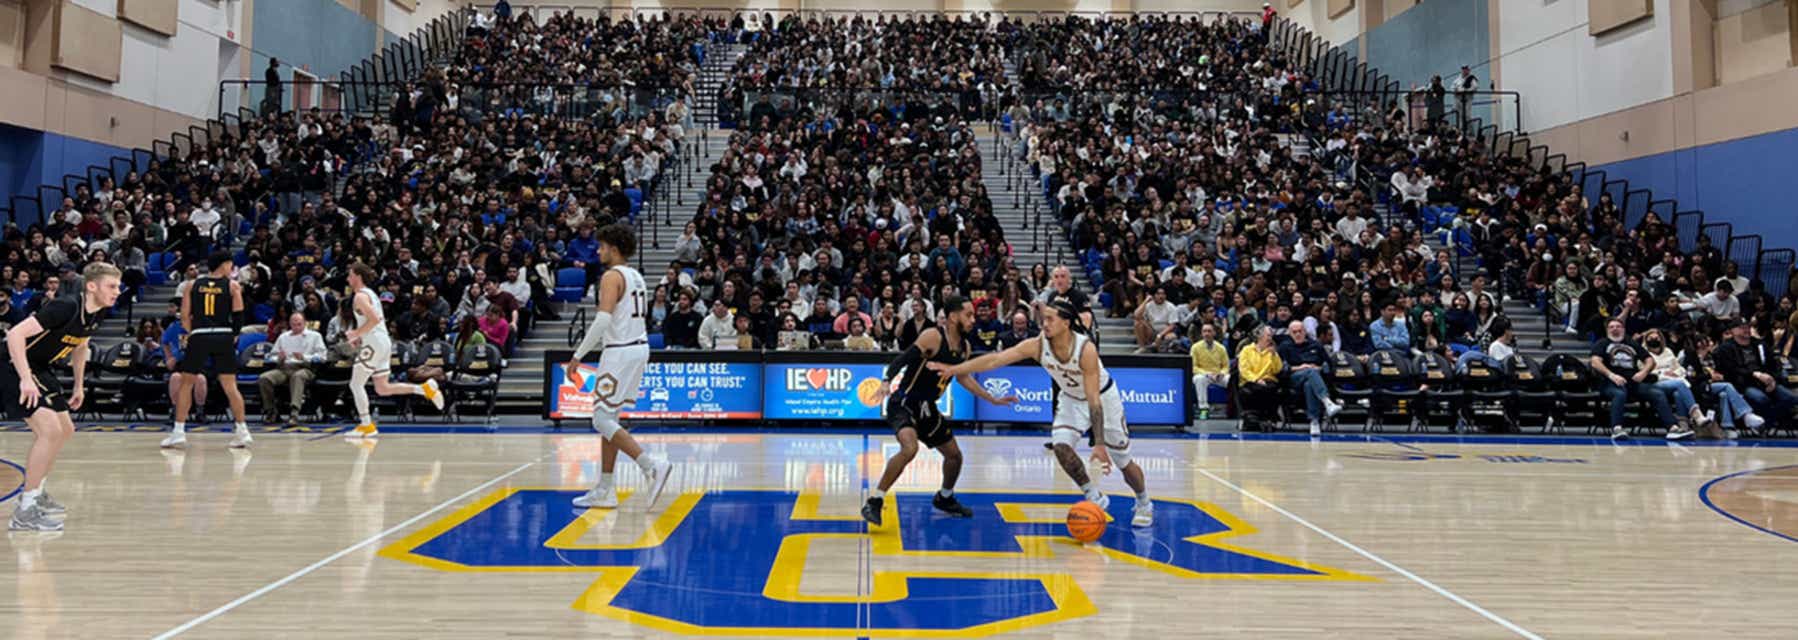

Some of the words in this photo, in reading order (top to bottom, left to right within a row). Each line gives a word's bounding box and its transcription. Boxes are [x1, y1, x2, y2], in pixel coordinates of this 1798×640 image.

[203, 293, 216, 316] 11
[630, 289, 646, 318] 11
[664, 363, 684, 374] YOU
[686, 363, 706, 374] CAN
[709, 363, 730, 374] SEE.
[665, 376, 685, 388] YOU
[687, 376, 708, 388] CAN
[1120, 389, 1174, 403] Mutual
[1014, 404, 1041, 412] Ontario
